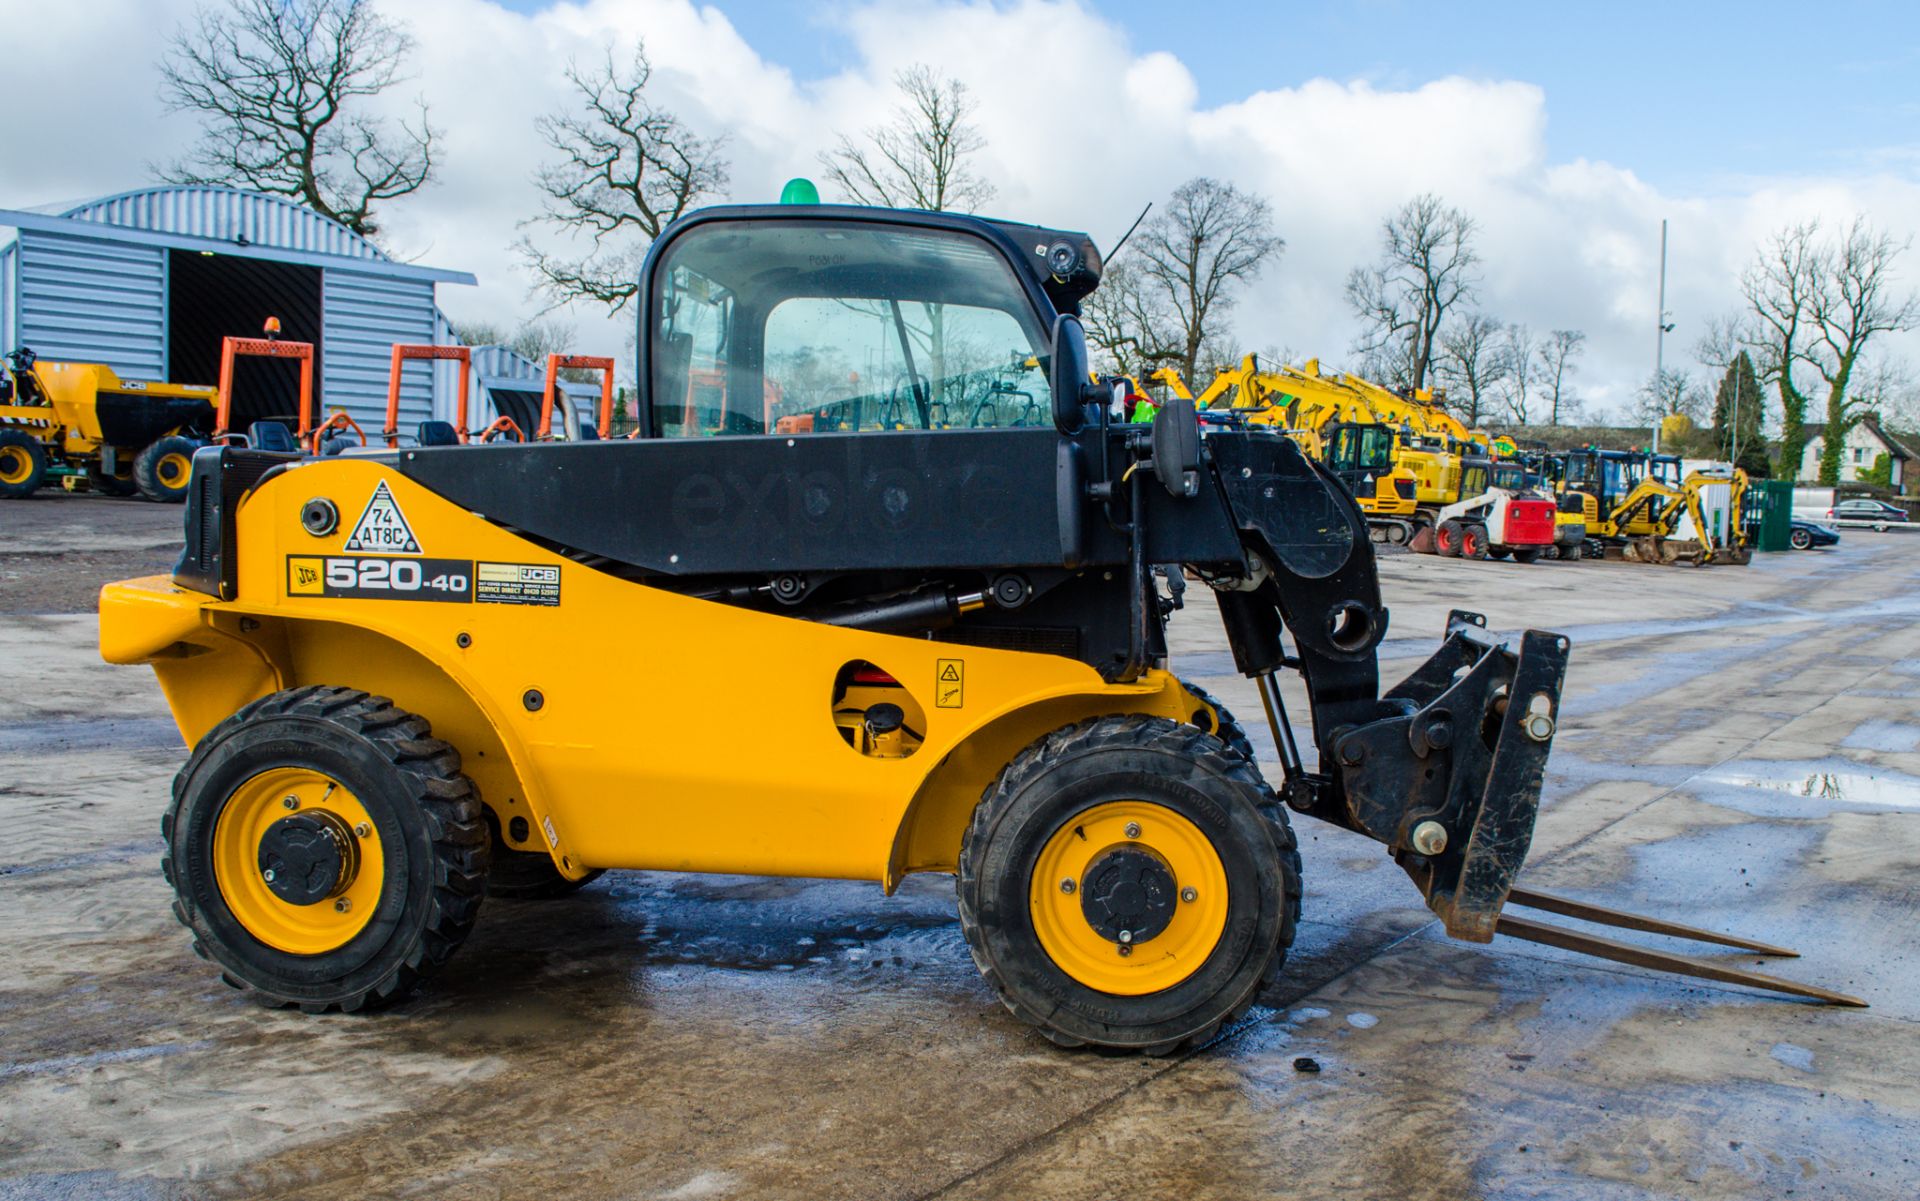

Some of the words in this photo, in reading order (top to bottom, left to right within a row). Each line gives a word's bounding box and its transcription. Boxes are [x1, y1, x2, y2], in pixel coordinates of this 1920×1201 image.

[120, 381, 147, 390] JCB
[373, 508, 392, 525] 74
[362, 527, 403, 544] AT8C
[298, 567, 318, 584] JCB
[522, 568, 556, 581] JCB
